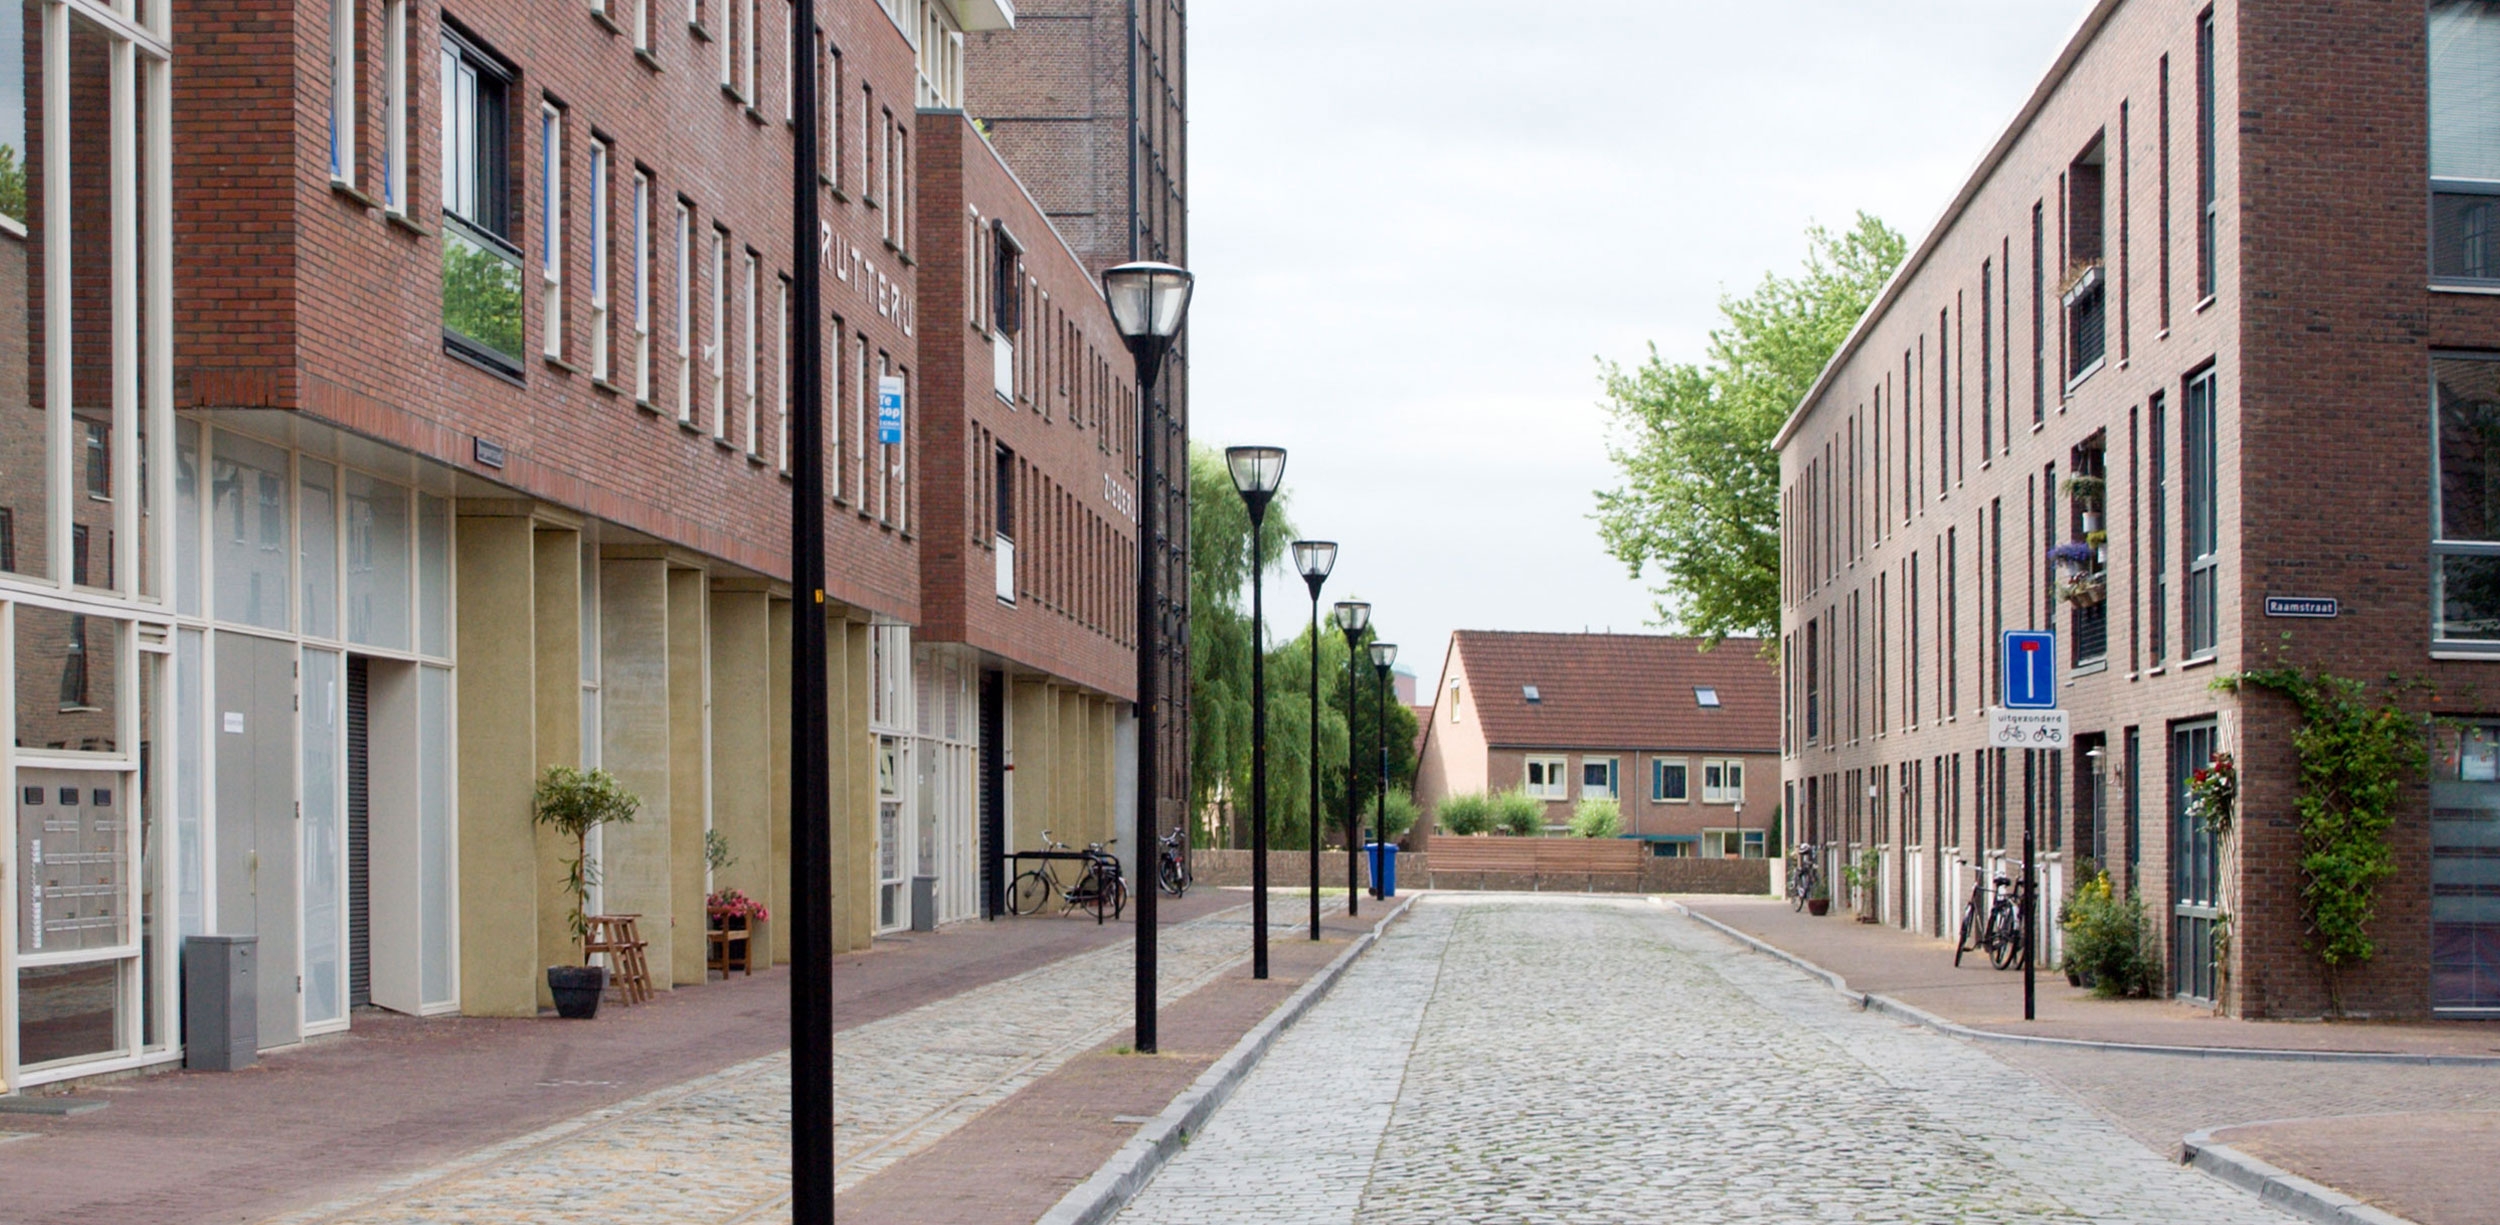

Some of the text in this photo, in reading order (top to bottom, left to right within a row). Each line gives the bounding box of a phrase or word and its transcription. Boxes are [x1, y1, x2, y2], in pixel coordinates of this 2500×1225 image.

[879, 406, 900, 420] oop
[2270, 601, 2334, 613] Raamstraat
[1998, 714, 2062, 723] uitgezonderd
